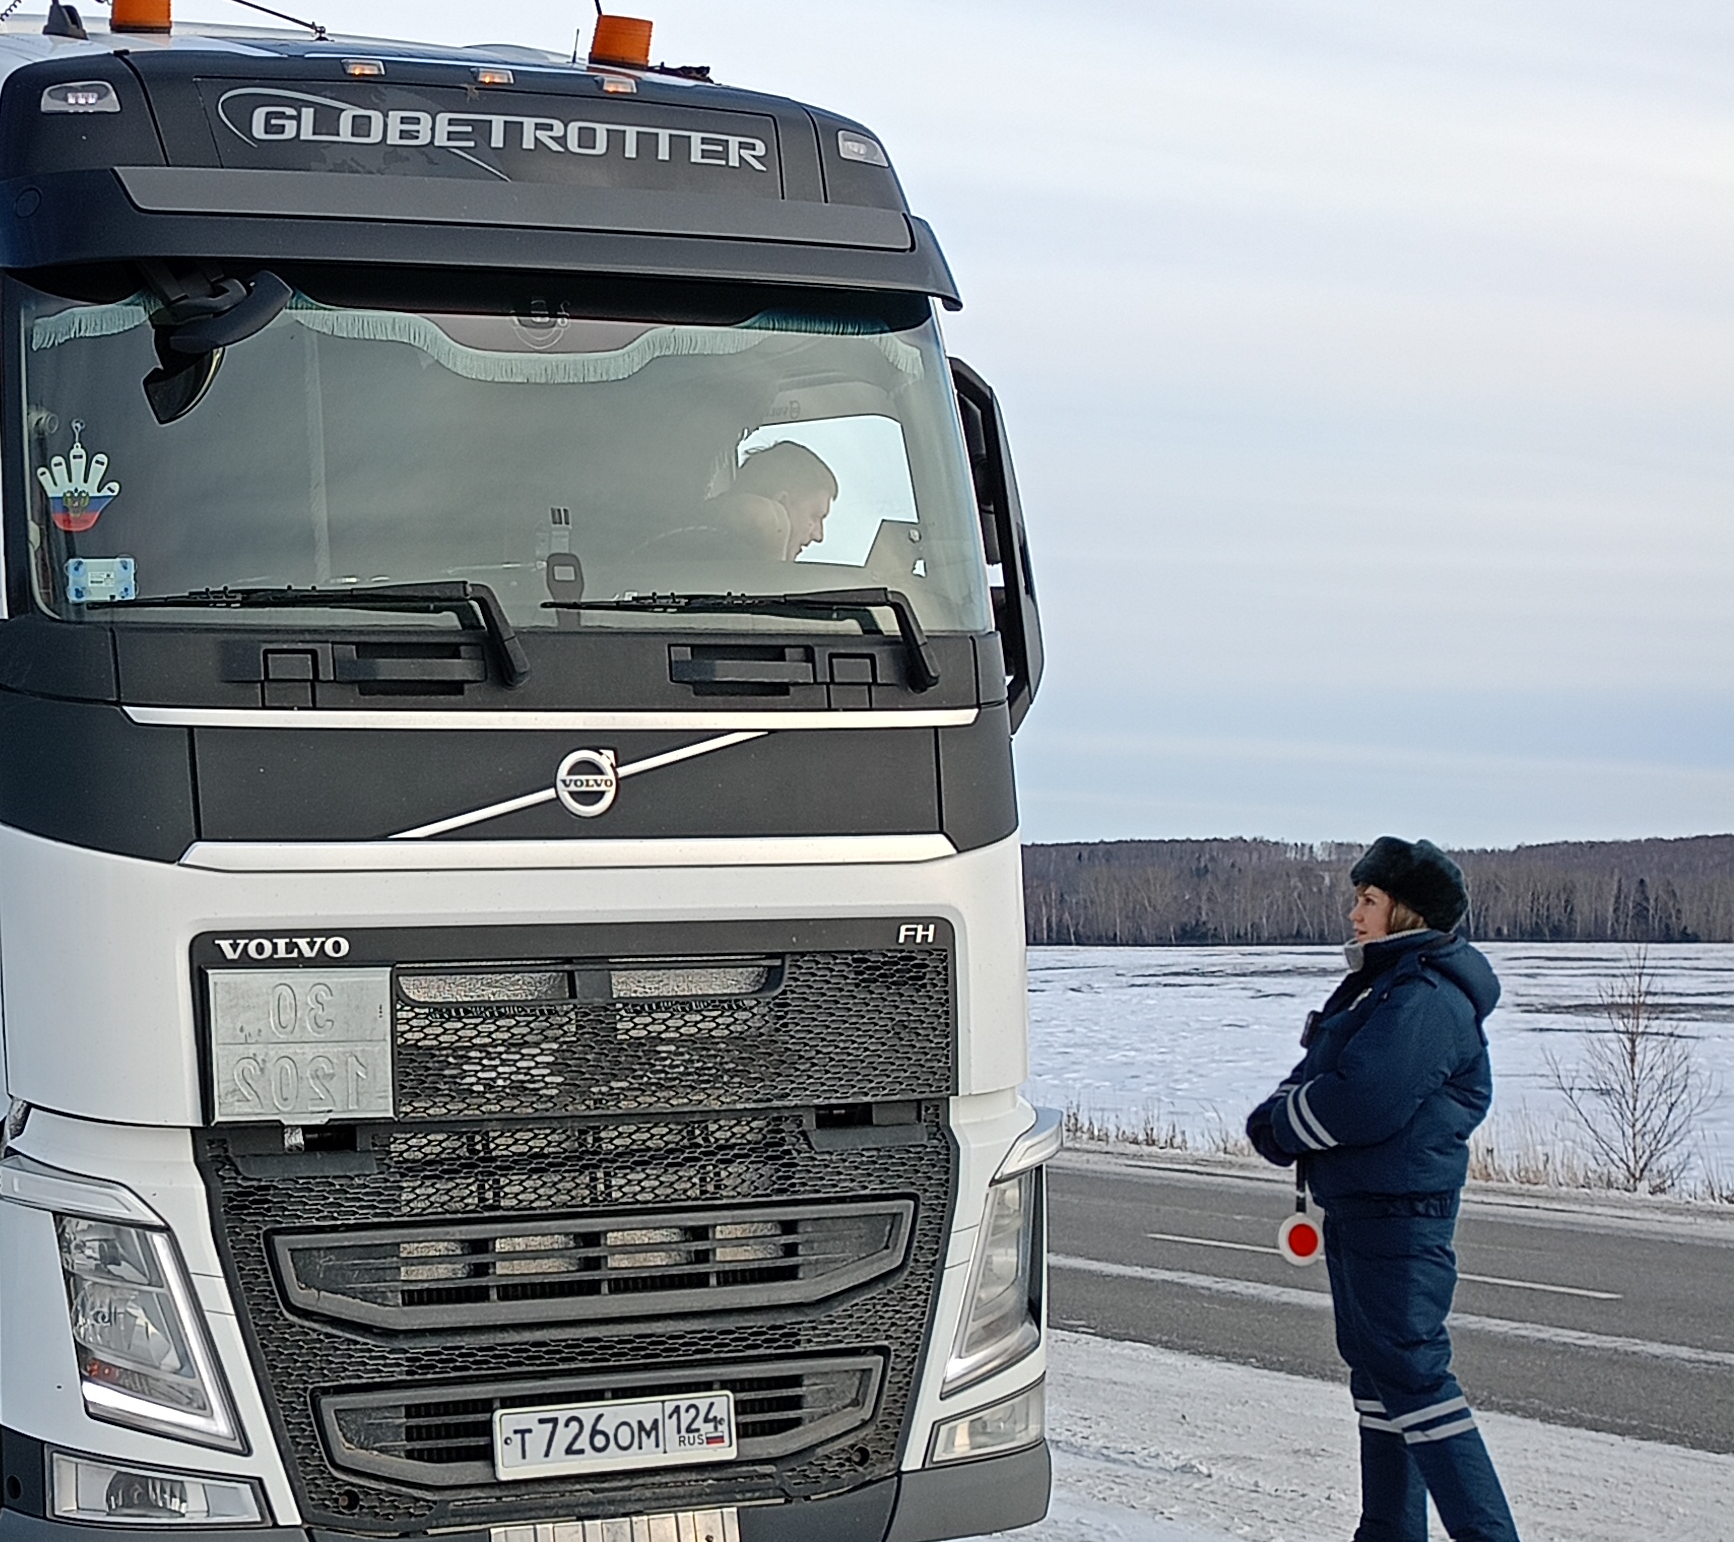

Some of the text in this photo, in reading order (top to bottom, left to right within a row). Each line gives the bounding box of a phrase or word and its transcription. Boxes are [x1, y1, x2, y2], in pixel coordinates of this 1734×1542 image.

[251, 105, 768, 171] GLOBETROTTER
[559, 778, 614, 788] VOLVO
[897, 923, 935, 944] FH
[214, 936, 350, 959] VOLVO
[668, 1401, 719, 1436] 124
[678, 1433, 705, 1448] RUS
